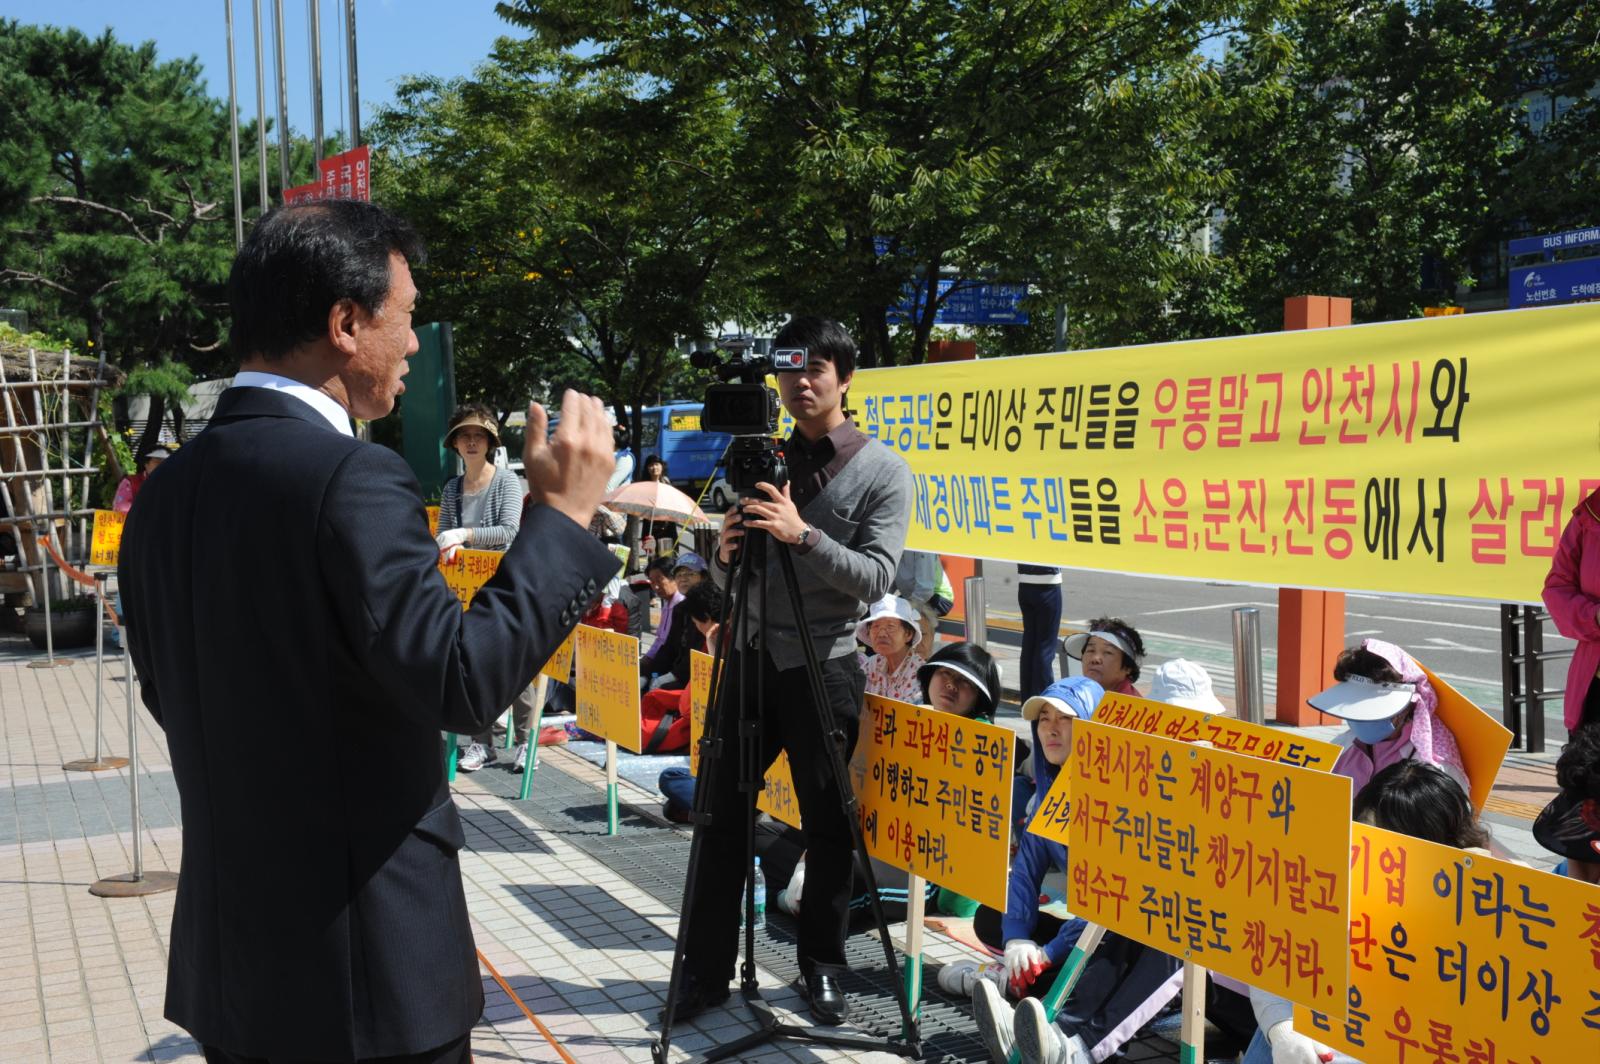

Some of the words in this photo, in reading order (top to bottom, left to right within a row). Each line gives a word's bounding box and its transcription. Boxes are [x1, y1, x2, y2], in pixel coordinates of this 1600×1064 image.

[1543, 236, 1562, 248] BUS
[1565, 230, 1600, 245] INFORM
[1526, 288, 1557, 302] 노선번호
[864, 391, 953, 452] 철도공단은
[960, 388, 1027, 453] 더이상
[1034, 380, 1140, 451] 주민들을
[1150, 372, 1283, 451] 우롱말고
[1298, 357, 1470, 446] 인천시와
[1133, 477, 1447, 563] 소음,분진,진동에서
[1468, 477, 1566, 565] 살려
[867, 702, 897, 748] 길과
[904, 717, 966, 768] 고남석은
[972, 733, 1008, 782] 공약
[1076, 731, 1177, 802] 인천시장은
[873, 757, 929, 808] 이행하고
[936, 778, 1004, 841] 주민들을
[1206, 834, 1340, 914] 챙기지말고
[1433, 860, 1556, 950] 이라는
[1073, 859, 1129, 922] 연수구
[1139, 884, 1232, 953] 주민들도
[1242, 919, 1333, 999] 챙겨라.
[1435, 940, 1562, 1037] 더이상
